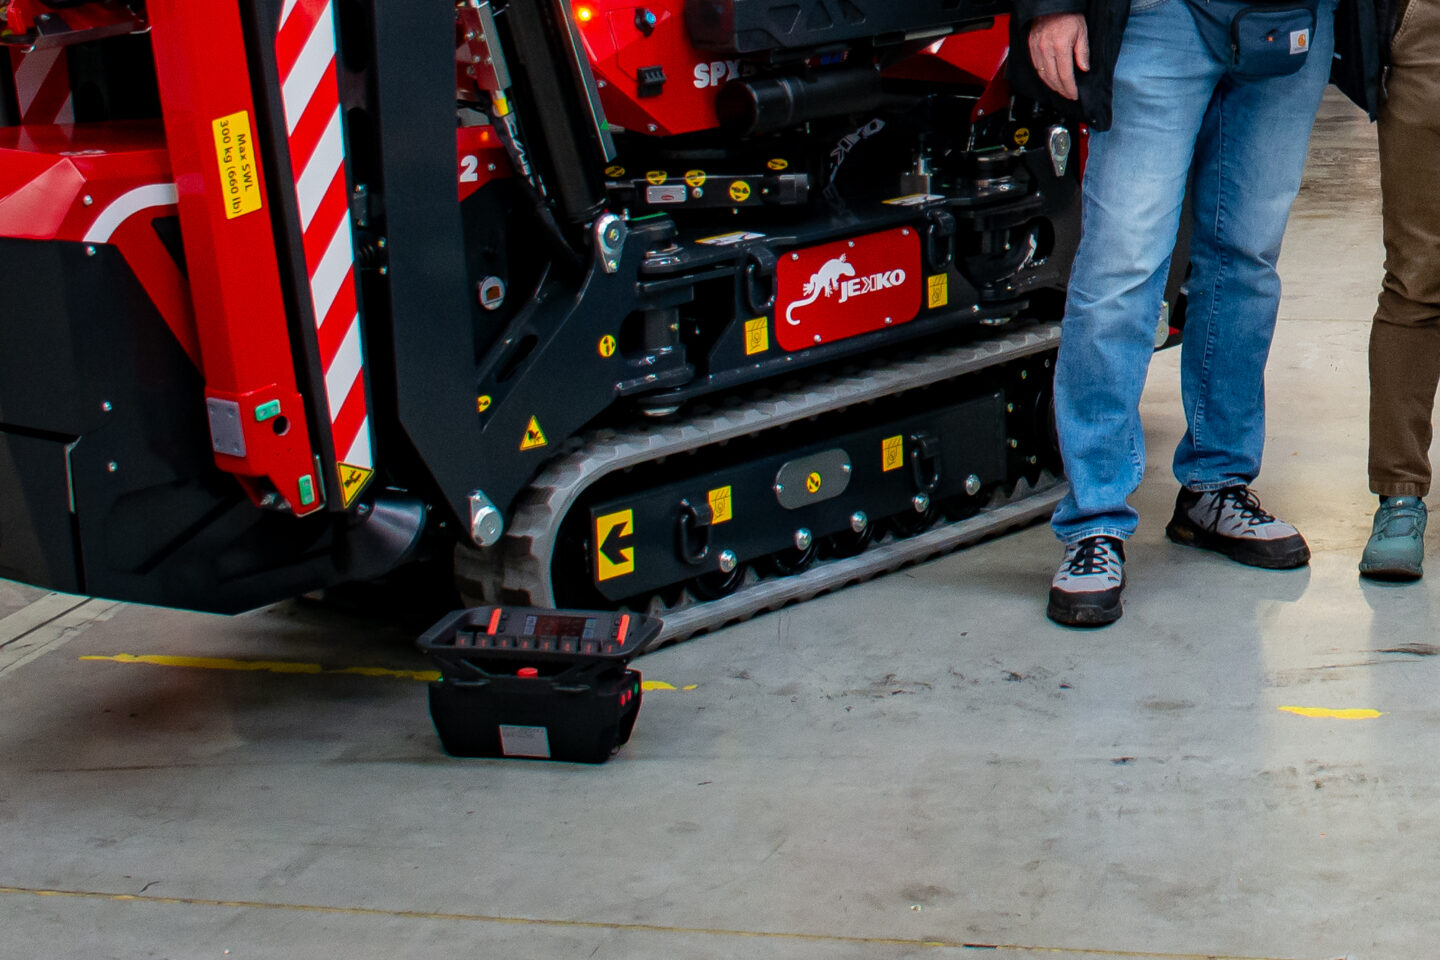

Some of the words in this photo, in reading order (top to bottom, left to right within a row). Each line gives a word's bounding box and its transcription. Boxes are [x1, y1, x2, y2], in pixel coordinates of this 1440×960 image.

[693, 60, 741, 89] SPX
[220, 120, 231, 144] 300
[223, 146, 233, 163] kg
[237, 133, 247, 160] Max
[227, 166, 239, 194] (660
[241, 163, 253, 192] SWL
[232, 197, 242, 214] lb)
[838, 268, 906, 303] JEKKO
